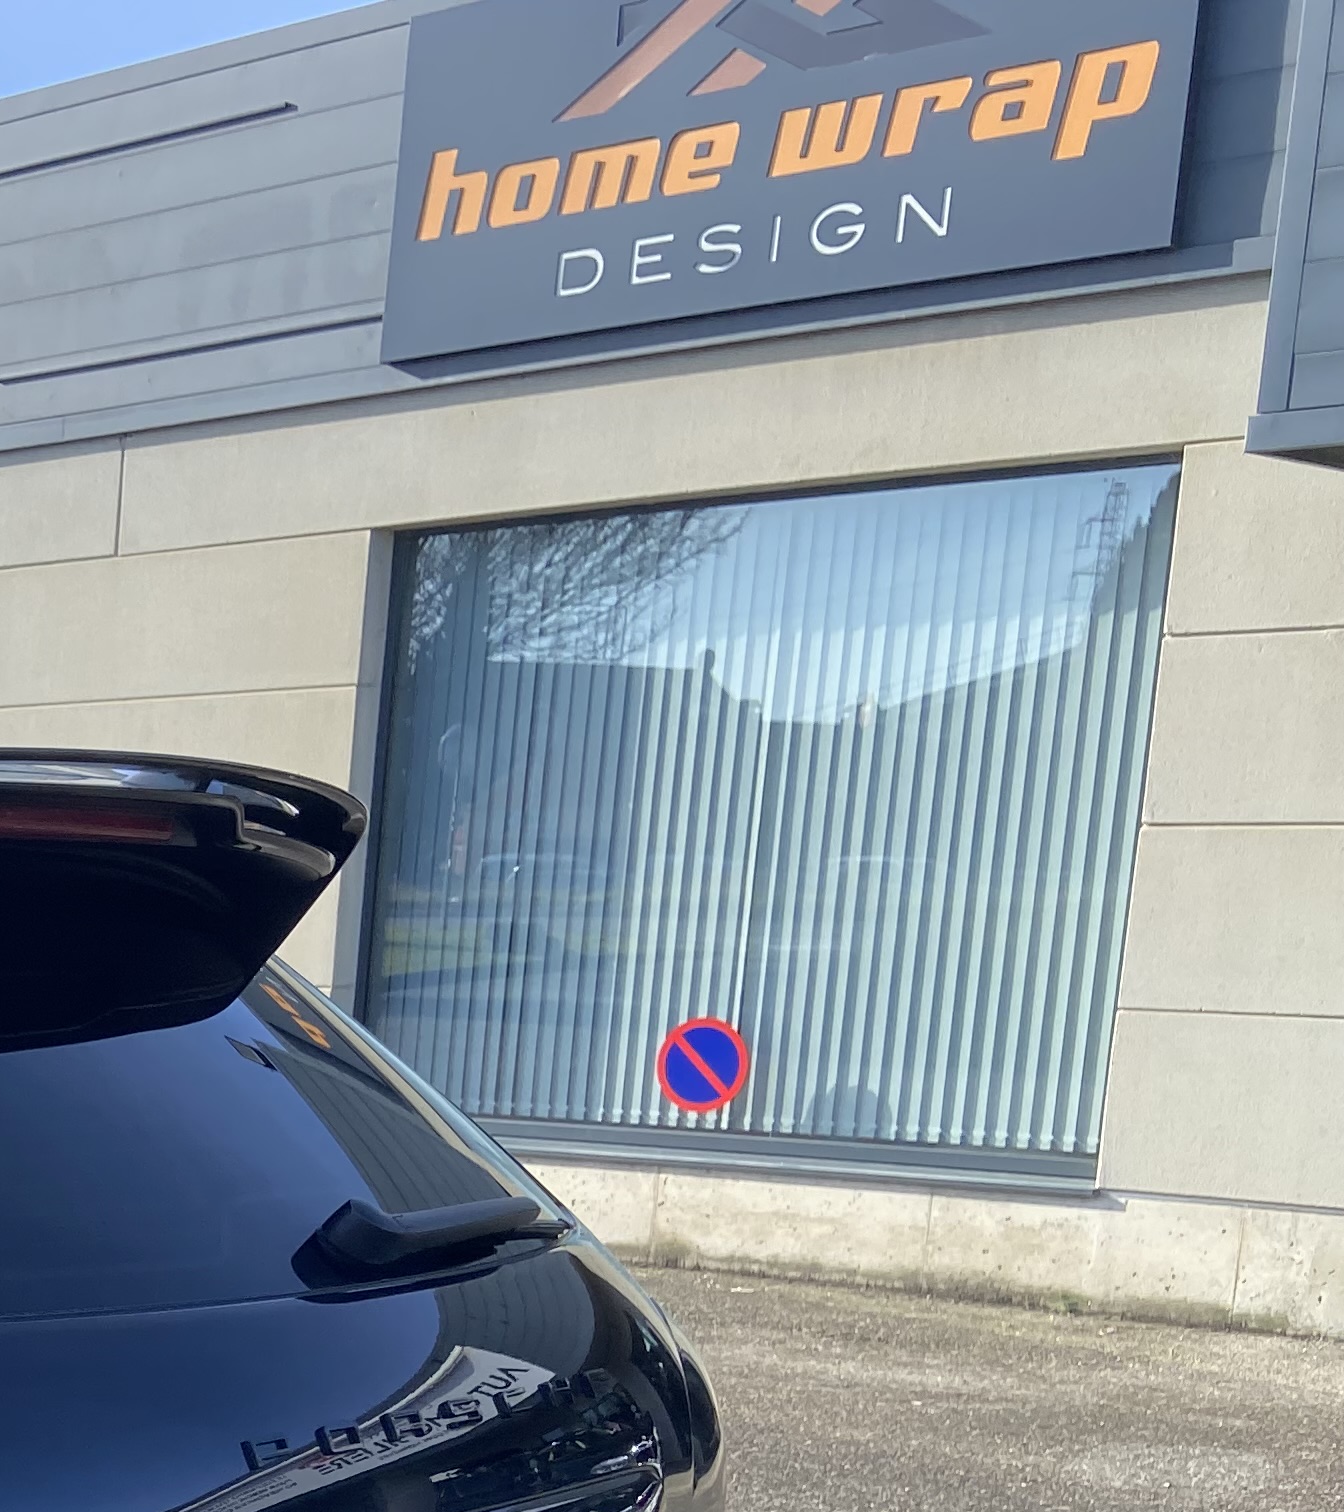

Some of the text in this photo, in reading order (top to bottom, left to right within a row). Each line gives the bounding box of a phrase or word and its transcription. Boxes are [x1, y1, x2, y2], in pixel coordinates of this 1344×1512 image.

[416, 40, 1160, 242] home wrap
[555, 186, 953, 298] DESIGN
